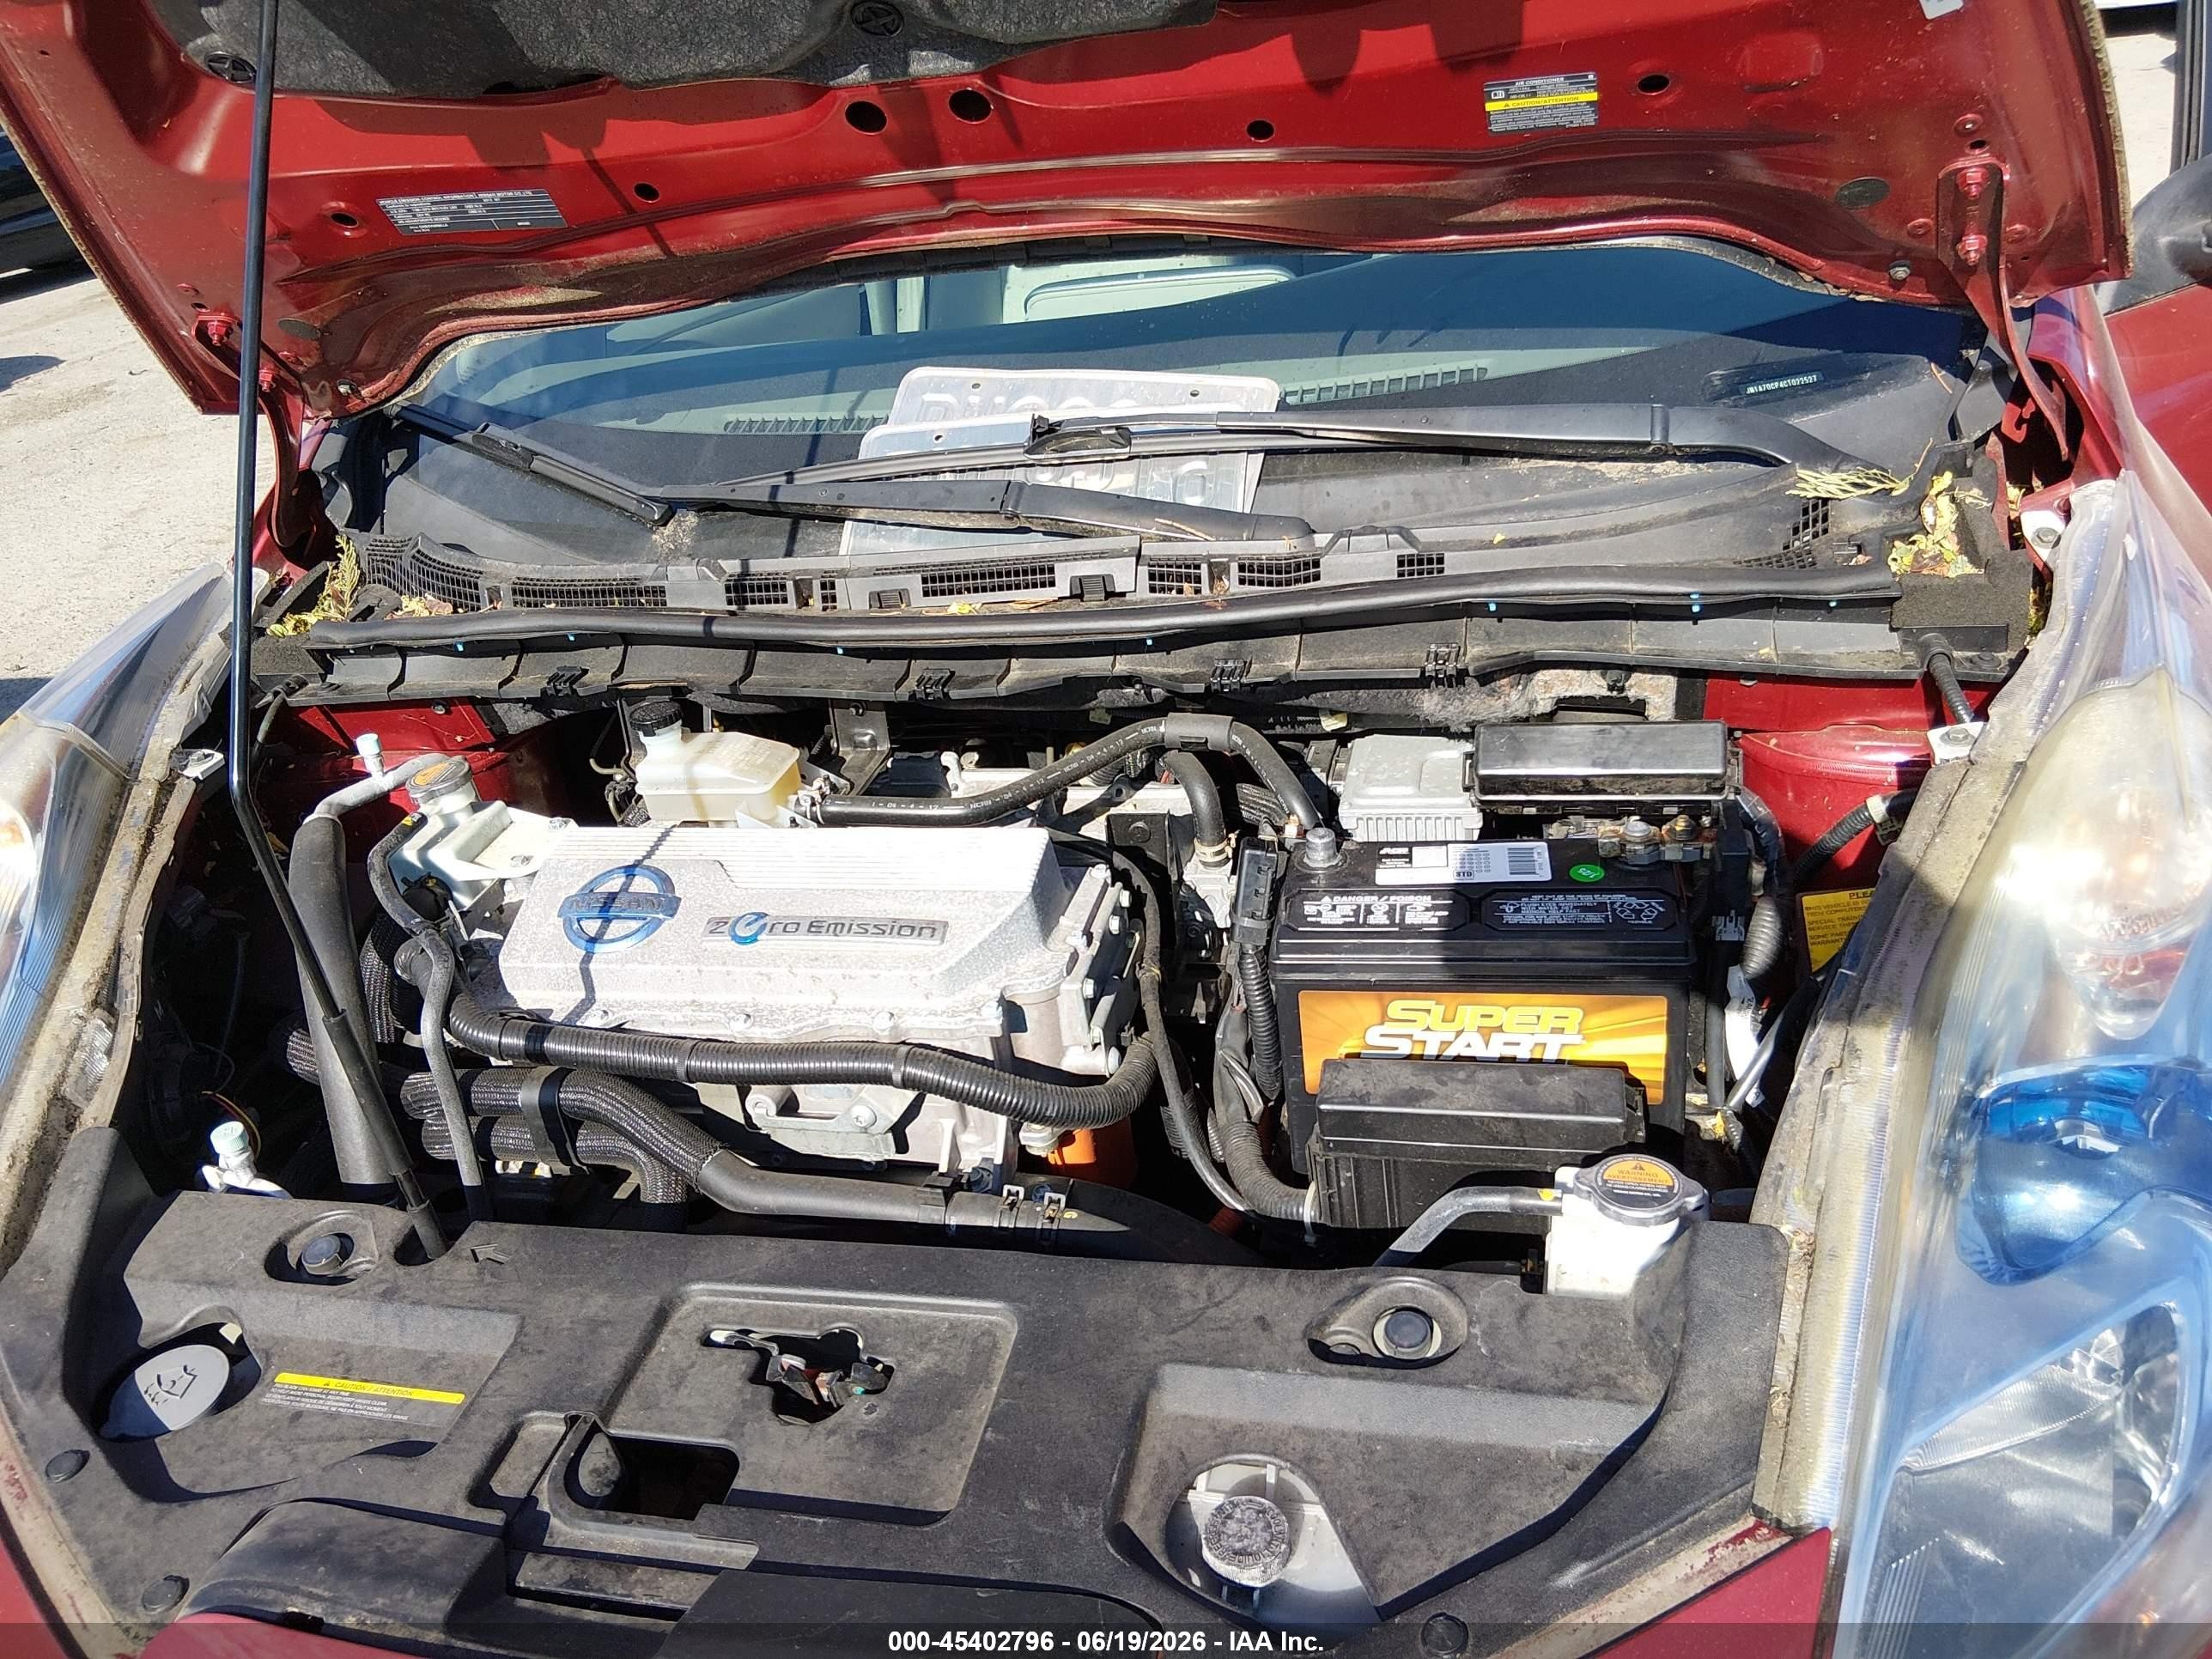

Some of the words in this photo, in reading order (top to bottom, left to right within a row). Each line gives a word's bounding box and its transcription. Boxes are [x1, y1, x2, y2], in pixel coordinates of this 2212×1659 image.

[568, 896, 665, 911] NISSAN
[1385, 1000, 1584, 1035] SUPER
[1360, 1023, 1583, 1064] START
[1617, 1169, 1659, 1178] WARNING
[334, 1381, 368, 1391] CAUTION
[374, 1385, 414, 1396] ATTENTION
